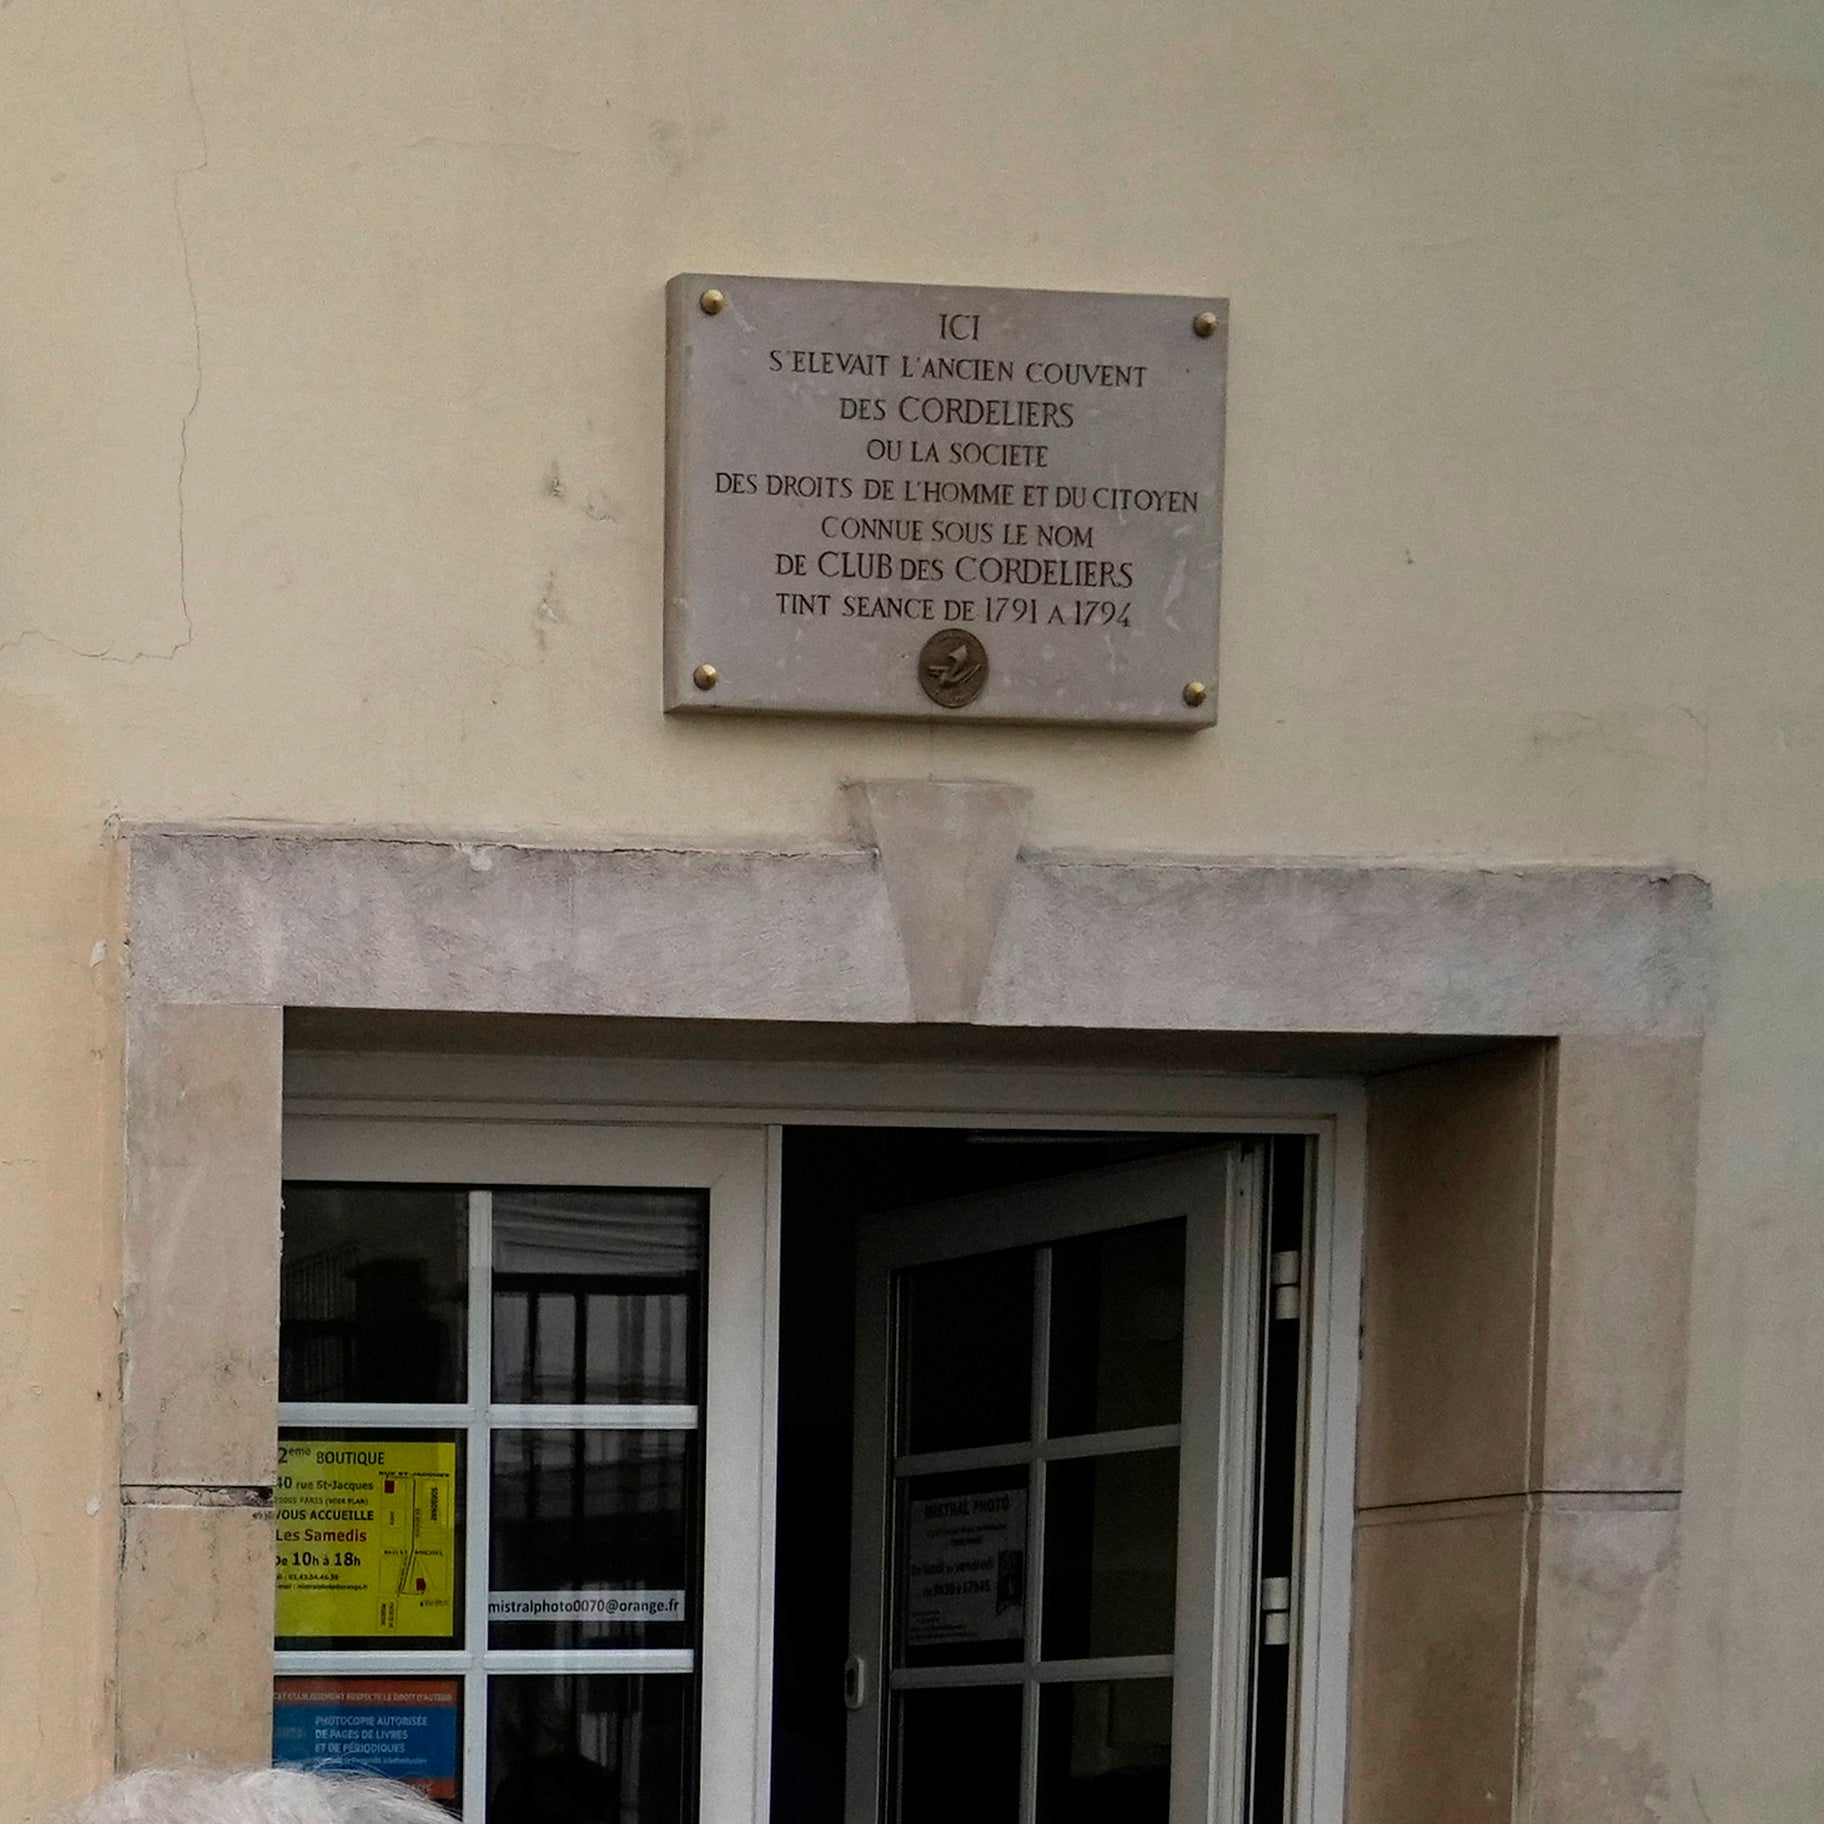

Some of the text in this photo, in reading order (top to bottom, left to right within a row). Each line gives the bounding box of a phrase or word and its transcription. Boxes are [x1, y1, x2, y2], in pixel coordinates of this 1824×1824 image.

[940, 314, 979, 341] ICI
[770, 350, 1147, 387] S'ELEVAIT L'ANCIEN COUVENT
[840, 396, 1073, 428] DES CORDELIERS
[867, 439, 1048, 467] OU LA SOCIETE
[715, 473, 1197, 512] DES DROITS DE L'HOMME ET DU CITOYEN
[822, 516, 1093, 548] CONNUE SOUS LE NOM
[776, 551, 1132, 588] DE CLUB DES CORDELIERS
[776, 593, 1131, 627] TINT SEANCE DE 1791 A 1794
[316, 1451, 384, 1465] BOUTIQUE
[316, 1479, 374, 1492] St-Jacques
[309, 1509, 374, 1521] ACCUEILLE
[275, 1528, 367, 1542] Les Samedis
[292, 1552, 319, 1566] 10h
[334, 1552, 361, 1566] 18h
